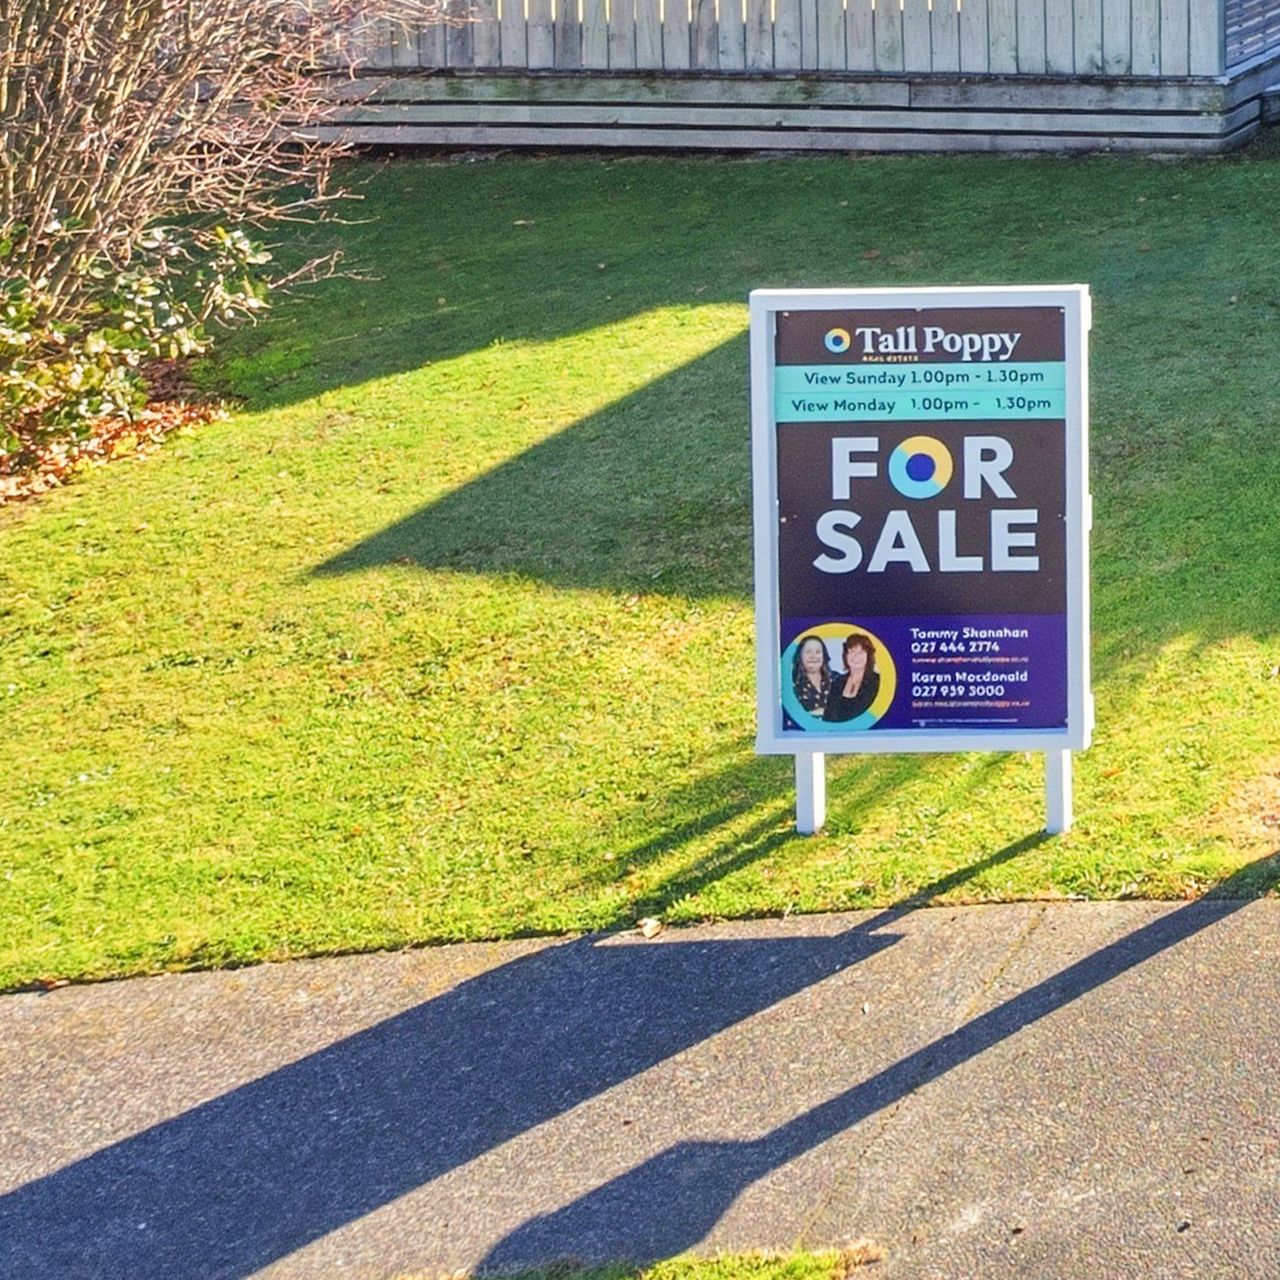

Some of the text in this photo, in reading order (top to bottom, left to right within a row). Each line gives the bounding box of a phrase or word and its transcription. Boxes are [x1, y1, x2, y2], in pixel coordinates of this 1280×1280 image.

[855, 326, 1021, 361] Tall Poppy
[804, 372, 841, 385] View
[846, 371, 906, 387] Sunday
[911, 370, 970, 386] 1.00pm
[987, 370, 1044, 385] 1.30pm
[792, 400, 829, 412] View
[834, 398, 896, 414] Monday
[911, 398, 968, 413] 1.00pm
[996, 397, 1051, 412] 1.30pm
[831, 435, 1018, 501] FOR
[812, 508, 1040, 574] SALE
[910, 627, 1029, 640] Tammy Shanahan
[911, 642, 936, 653] 027
[912, 672, 951, 683] Karen
[912, 685, 937, 697] 027
